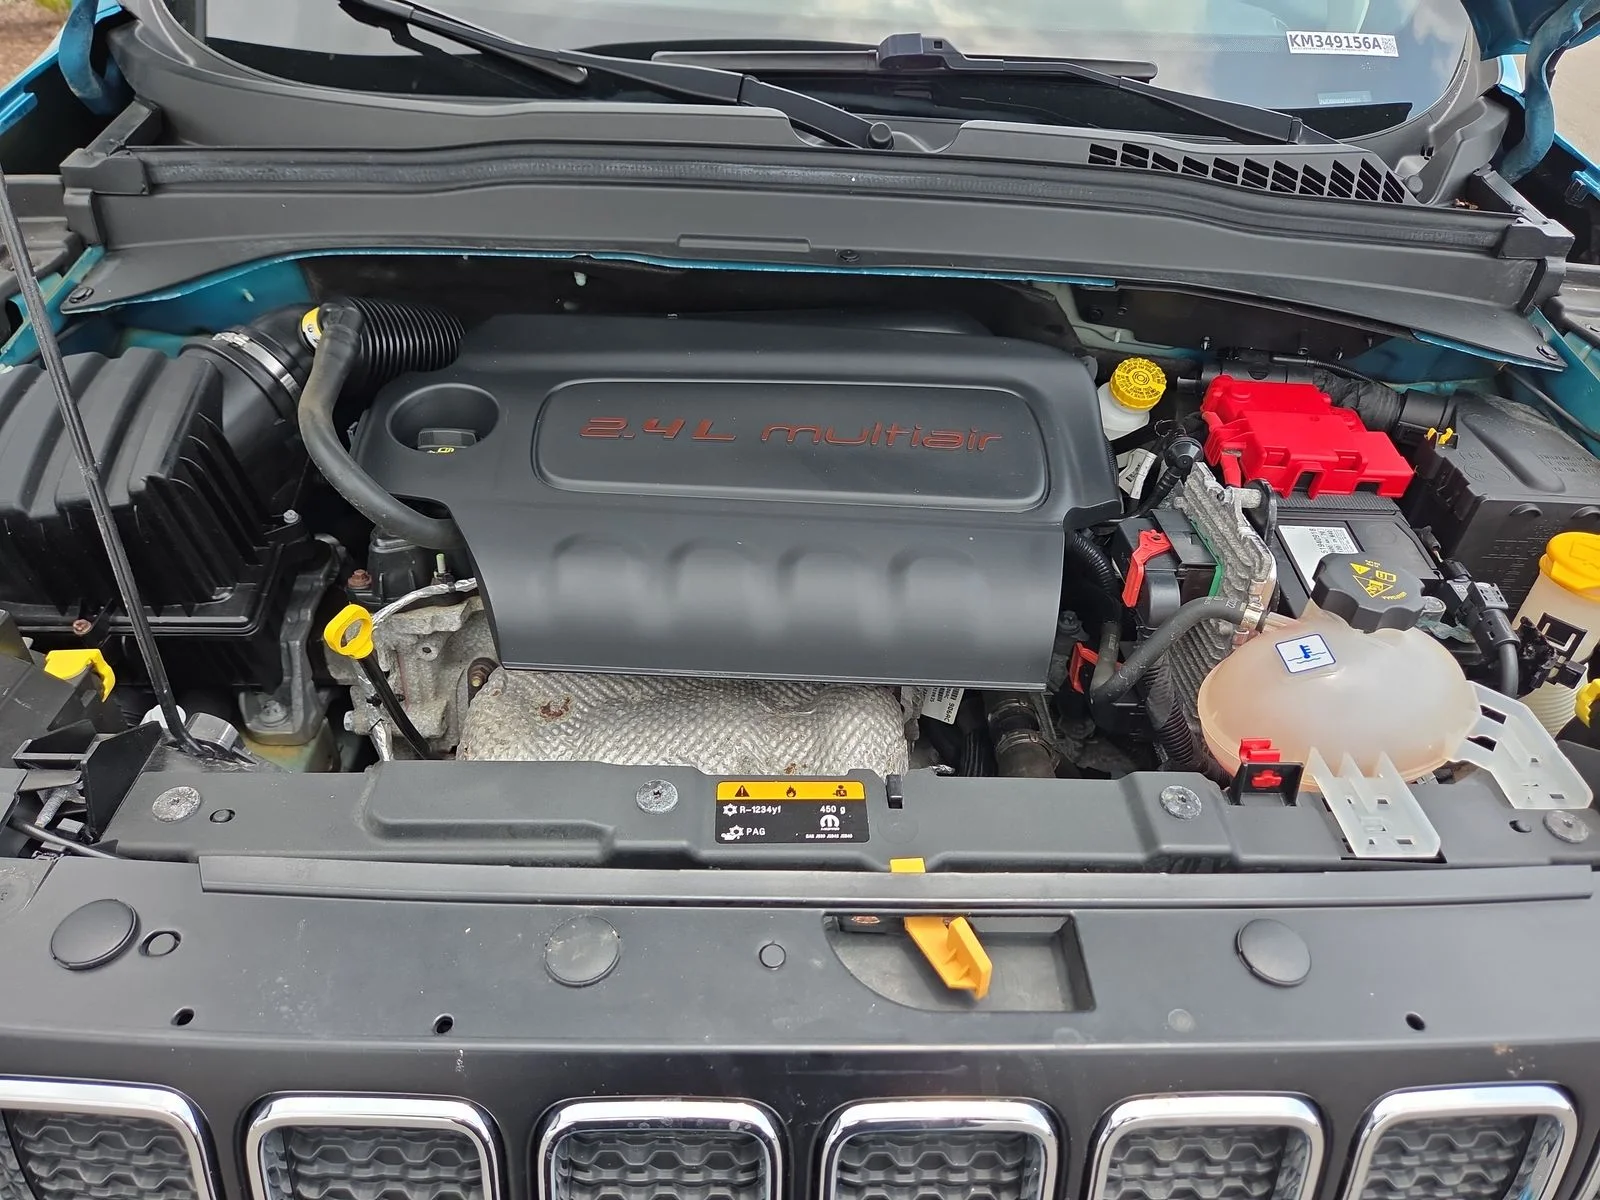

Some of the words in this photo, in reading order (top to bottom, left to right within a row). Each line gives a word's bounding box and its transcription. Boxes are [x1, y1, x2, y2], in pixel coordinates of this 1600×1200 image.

[1289, 34, 1382, 50] KM349156A
[761, 421, 1002, 450] multiair
[739, 805, 782, 815] R-1234yf
[820, 805, 836, 813] 450
[839, 806, 846, 815] g
[746, 828, 766, 836] PAG
